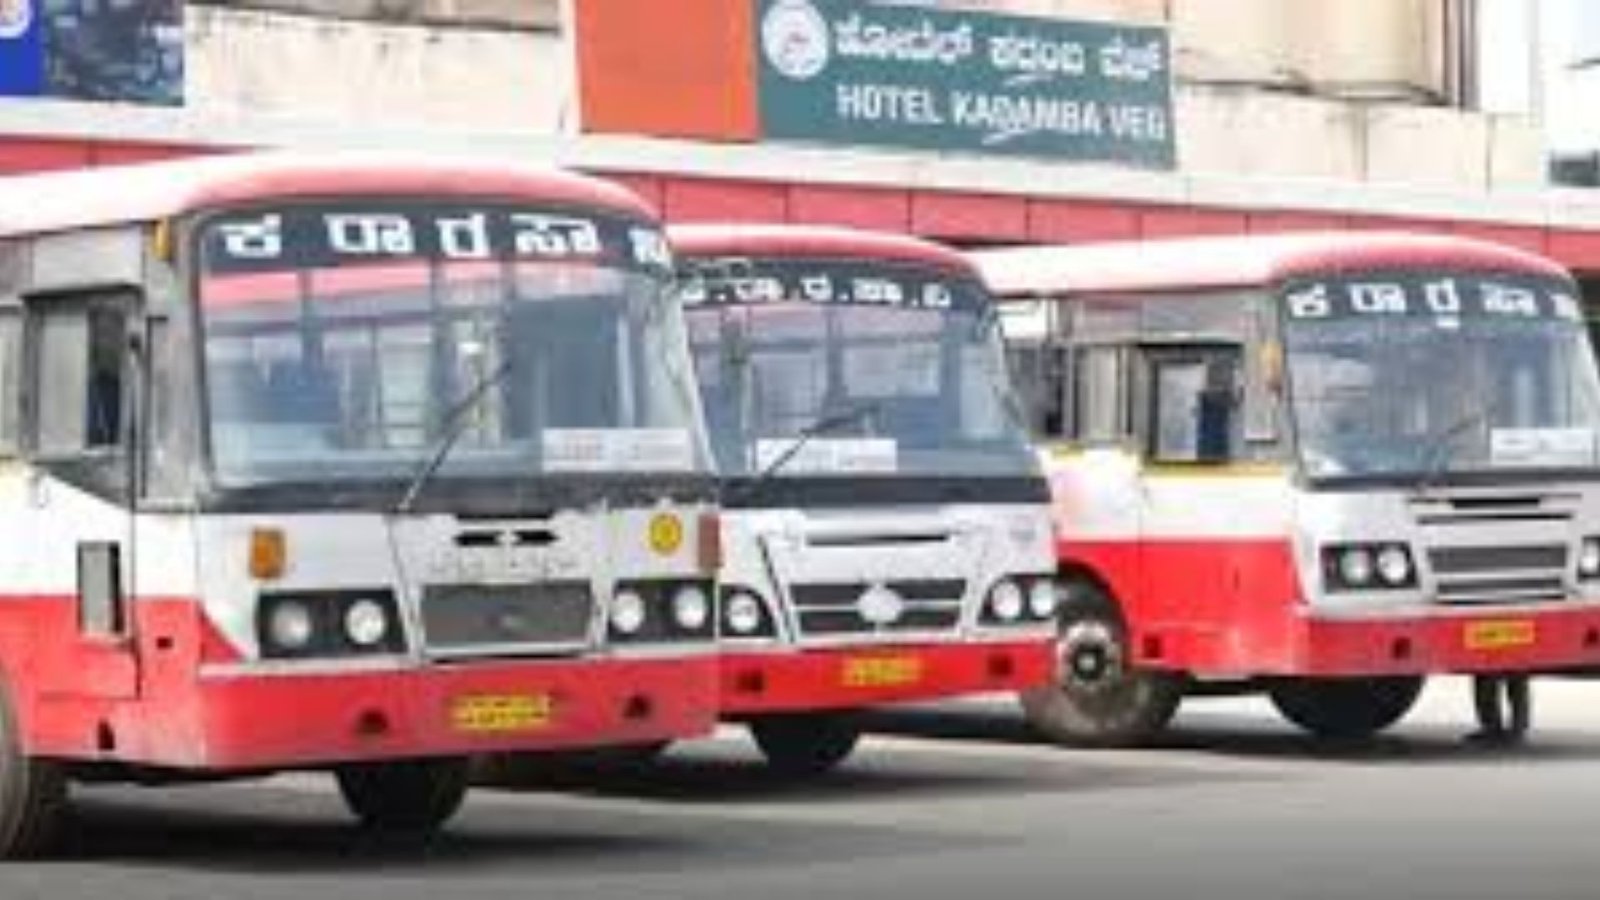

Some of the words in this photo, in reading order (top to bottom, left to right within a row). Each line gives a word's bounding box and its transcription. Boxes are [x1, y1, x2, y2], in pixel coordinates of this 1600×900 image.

[836, 83, 942, 125] HOTEL
[952, 91, 1101, 136] KADAMBA
[1109, 104, 1167, 141] VEG
